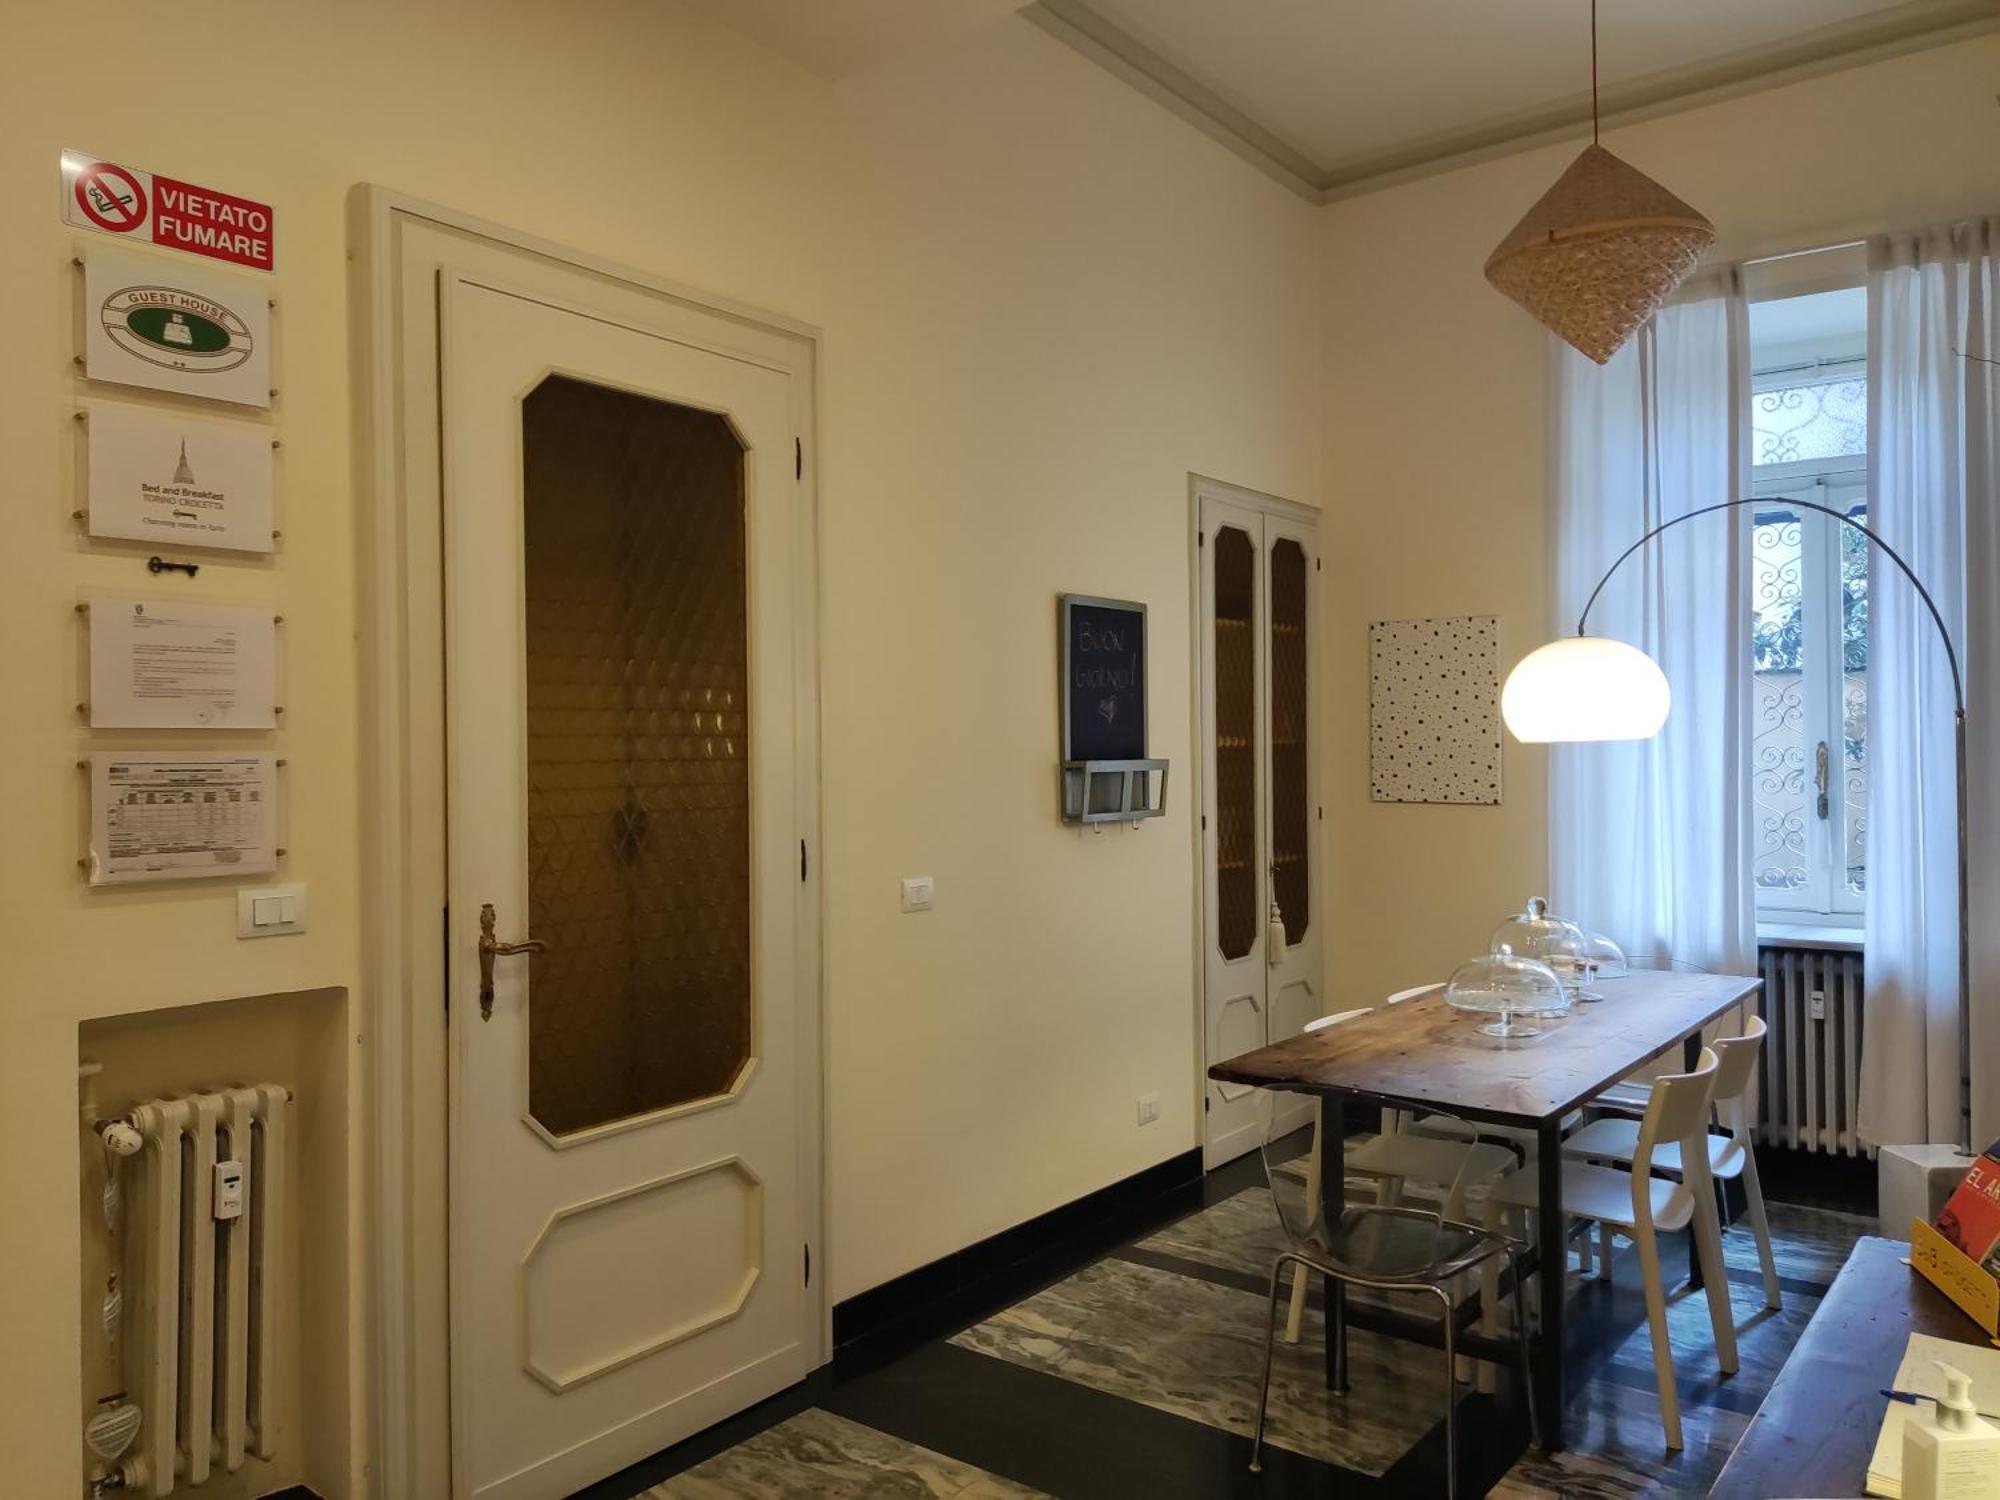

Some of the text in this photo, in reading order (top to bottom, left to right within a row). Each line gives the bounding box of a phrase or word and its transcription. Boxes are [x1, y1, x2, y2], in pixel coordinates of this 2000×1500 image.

[160, 187, 267, 233] VIETATO
[159, 215, 267, 260] FUMARE
[128, 292, 228, 320] GUEST HOUSE
[141, 483, 224, 500] Bed and Breakfast
[1965, 1167, 1985, 1189] EL
